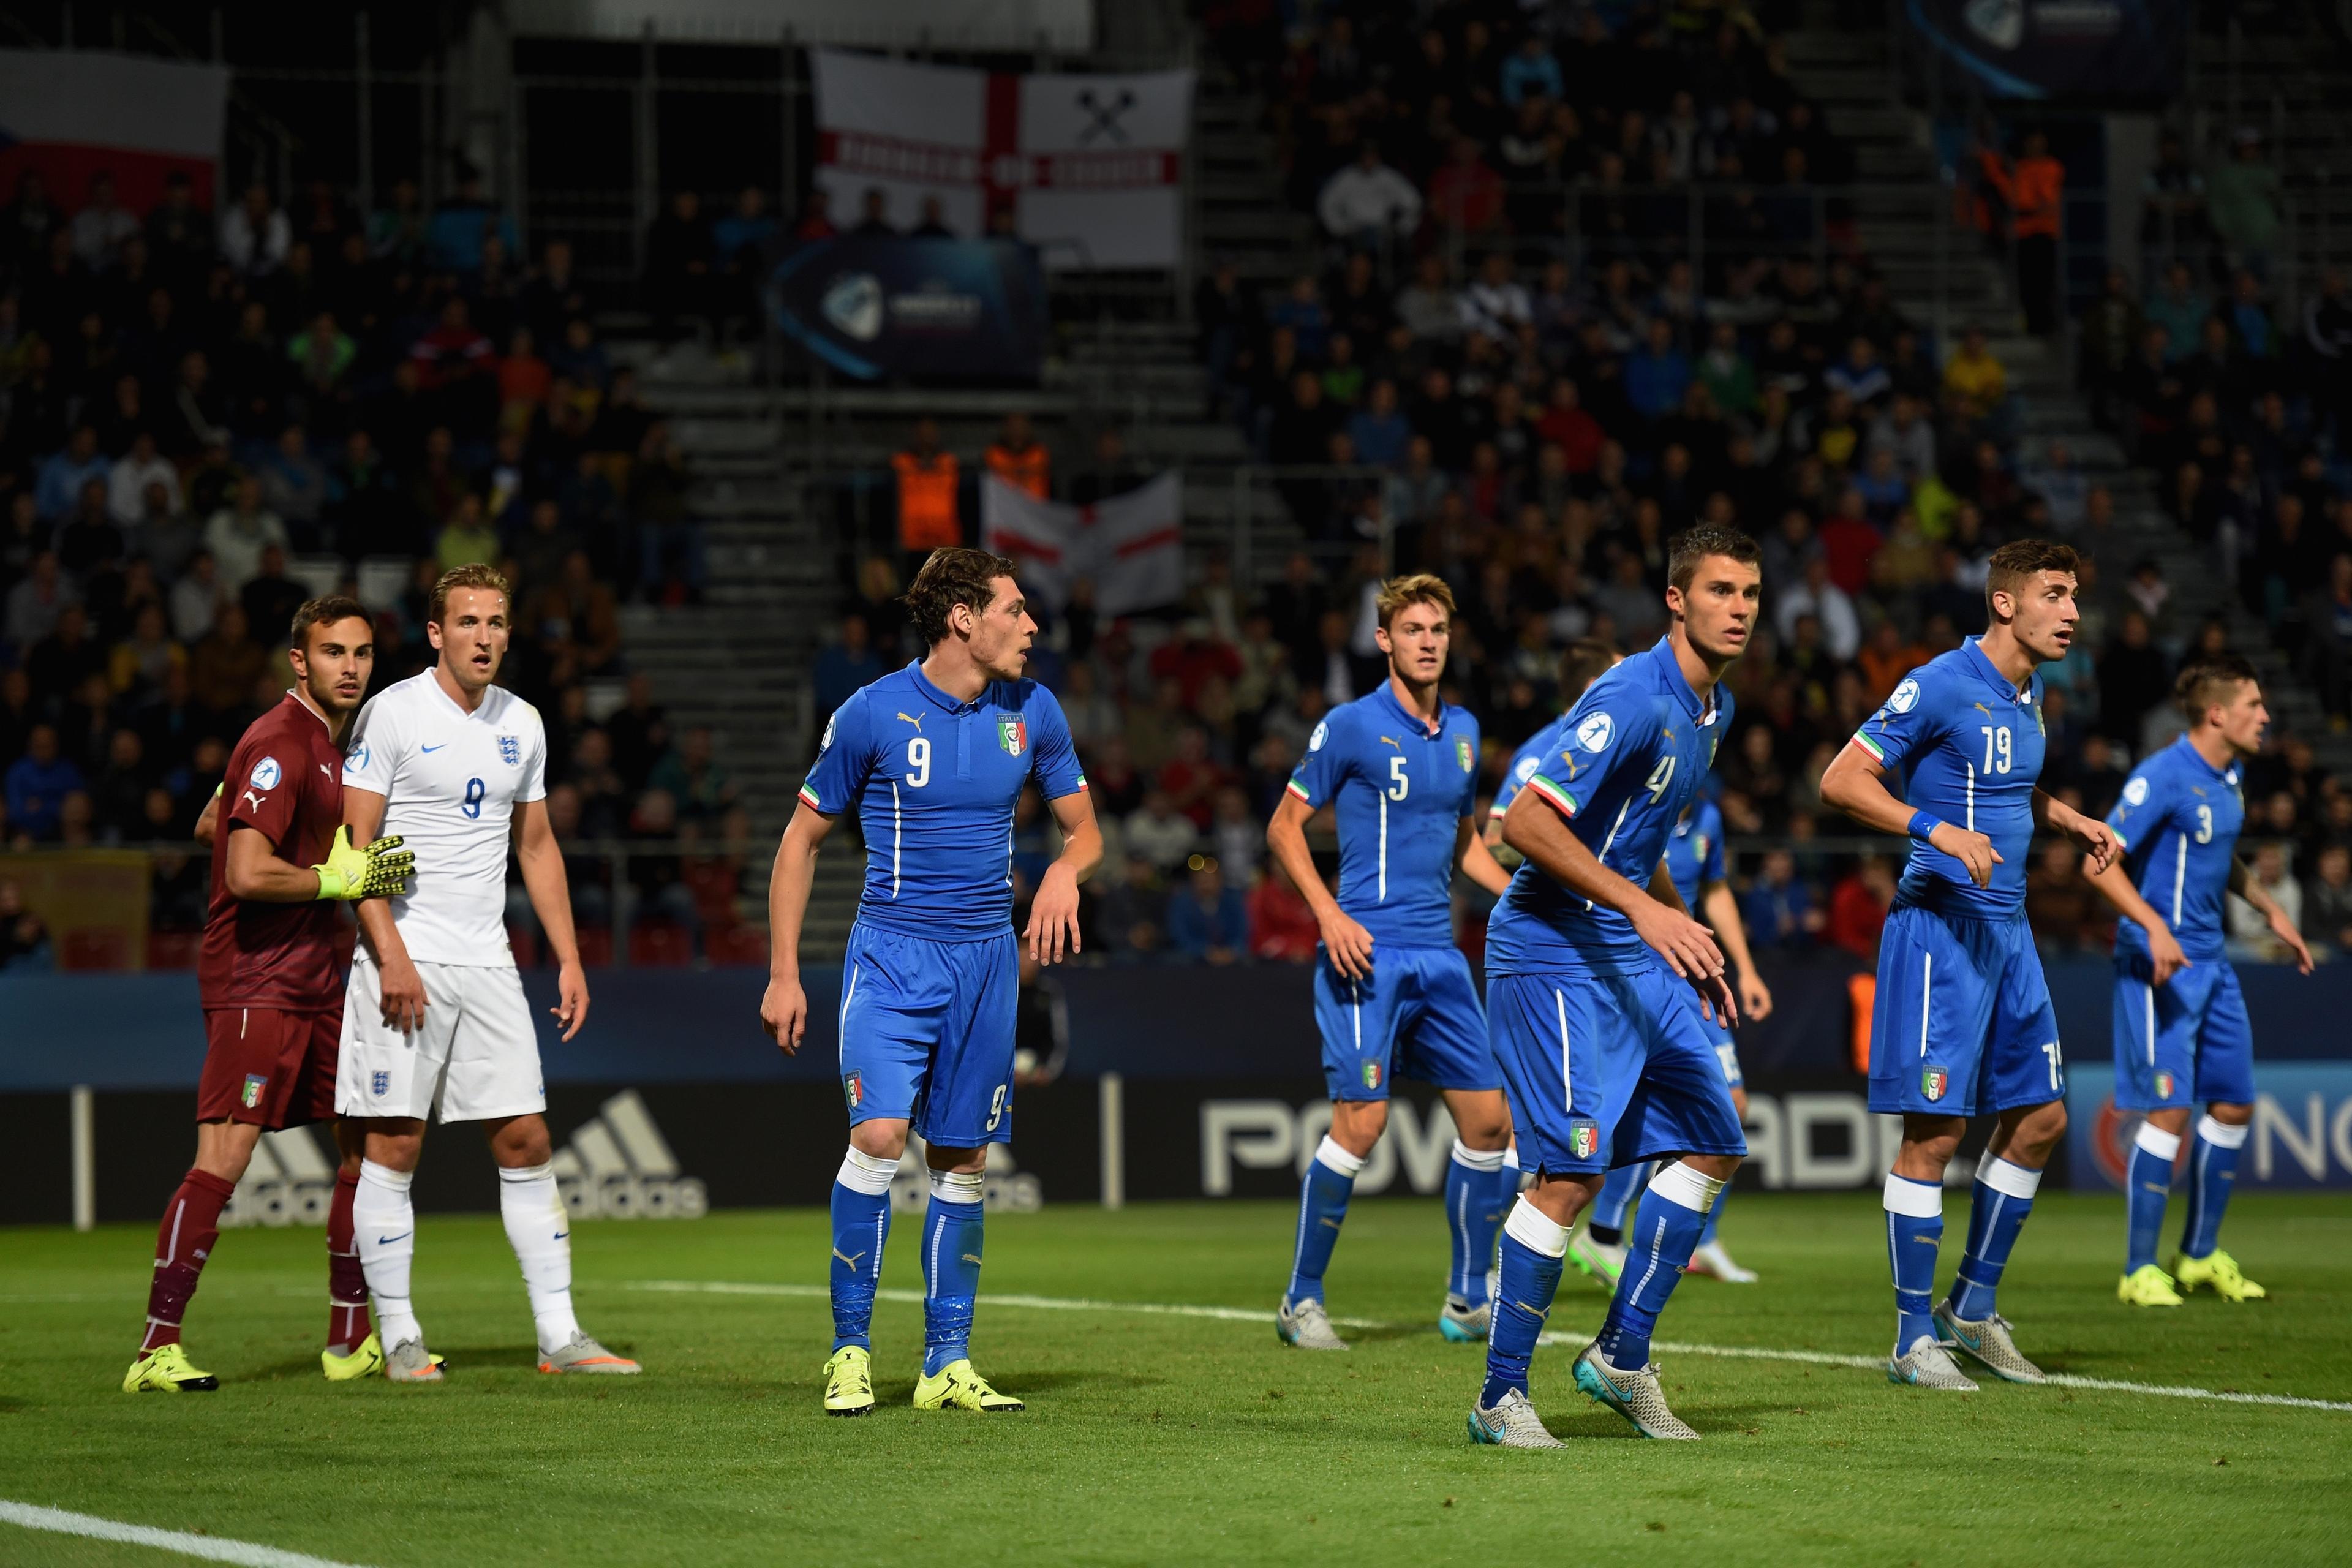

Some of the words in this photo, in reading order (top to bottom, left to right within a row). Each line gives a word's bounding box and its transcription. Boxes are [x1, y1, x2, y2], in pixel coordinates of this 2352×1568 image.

[907, 737, 931, 788] 9
[1981, 726, 2011, 775] 19
[461, 777, 485, 819] 9
[1388, 756, 1409, 801] 5
[1644, 756, 1676, 805] 4
[2195, 803, 2213, 845] 3
[986, 1084, 1008, 1133] 9
